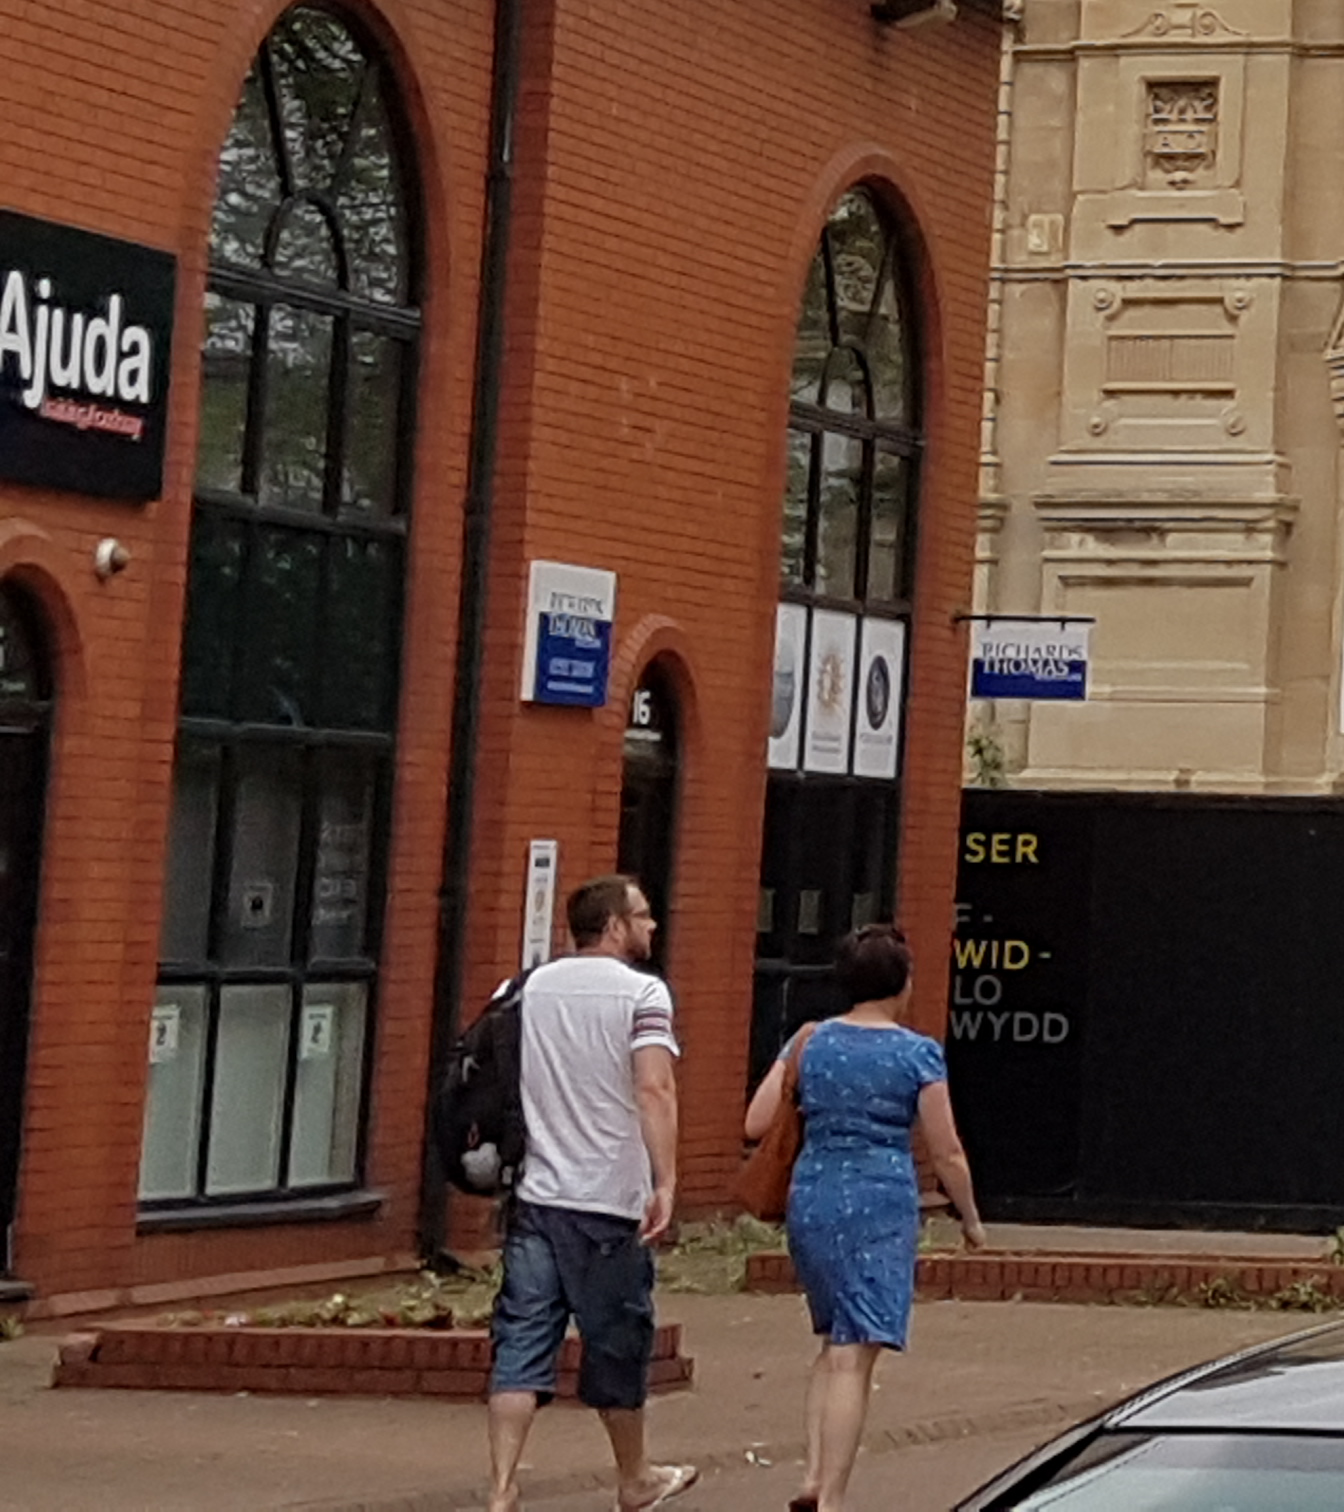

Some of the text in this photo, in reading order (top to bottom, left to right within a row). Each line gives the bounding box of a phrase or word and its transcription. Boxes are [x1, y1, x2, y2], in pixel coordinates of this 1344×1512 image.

[0, 271, 149, 408] Ajuda
[633, 690, 651, 725] 16
[964, 832, 1039, 864] SER
[953, 974, 1003, 1005] LO
[950, 1010, 1070, 1044] WYDD
